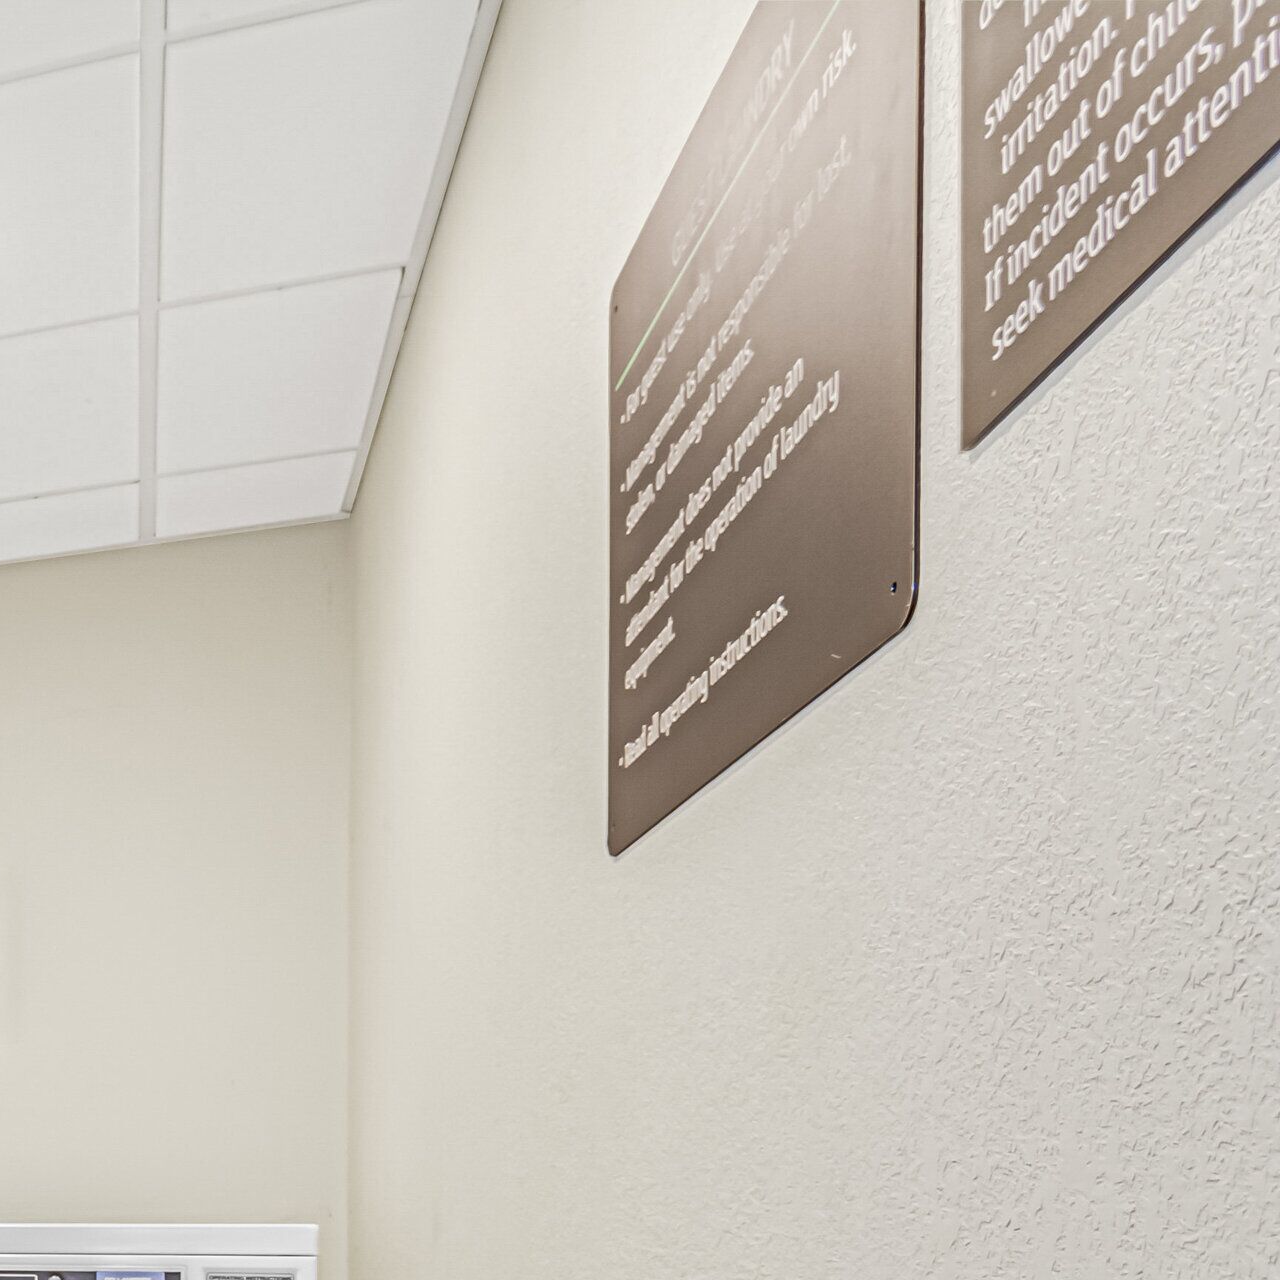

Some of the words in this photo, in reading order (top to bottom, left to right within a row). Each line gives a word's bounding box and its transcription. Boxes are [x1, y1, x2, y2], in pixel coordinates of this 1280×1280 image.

[984, 165, 1042, 253] them
[1047, 98, 1091, 176] out
[1096, 47, 1126, 118] of
[984, 255, 1005, 312] If
[1007, 141, 1109, 285] incident
[1115, 26, 1225, 163] occurs,
[1001, 17, 1119, 174] irritation.
[626, 385, 640, 421] For
[640, 338, 666, 404] guest
[667, 312, 685, 352] use
[789, 88, 818, 151] own
[822, 29, 856, 98] risk.
[992, 279, 1045, 361] seek
[1048, 147, 1160, 300] medical
[626, 382, 685, 491] Management
[685, 370, 696, 398] is
[697, 335, 716, 382] not
[717, 213, 789, 350] responsible
[793, 189, 814, 236] for
[655, 461, 666, 490] or
[666, 382, 715, 474] damaged
[716, 338, 754, 403] items.
[625, 508, 685, 603] Management
[685, 476, 711, 525] does
[712, 444, 732, 491] not
[733, 384, 782, 471] provide
[784, 357, 803, 397] an
[669, 559, 684, 592] for
[685, 537, 703, 573] the
[704, 466, 761, 551] operation
[763, 433, 779, 478] of
[780, 369, 839, 459] laundry
[624, 724, 646, 768] Read
[646, 711, 659, 746] all
[659, 670, 708, 736] operating
[709, 595, 788, 685] instructions.
